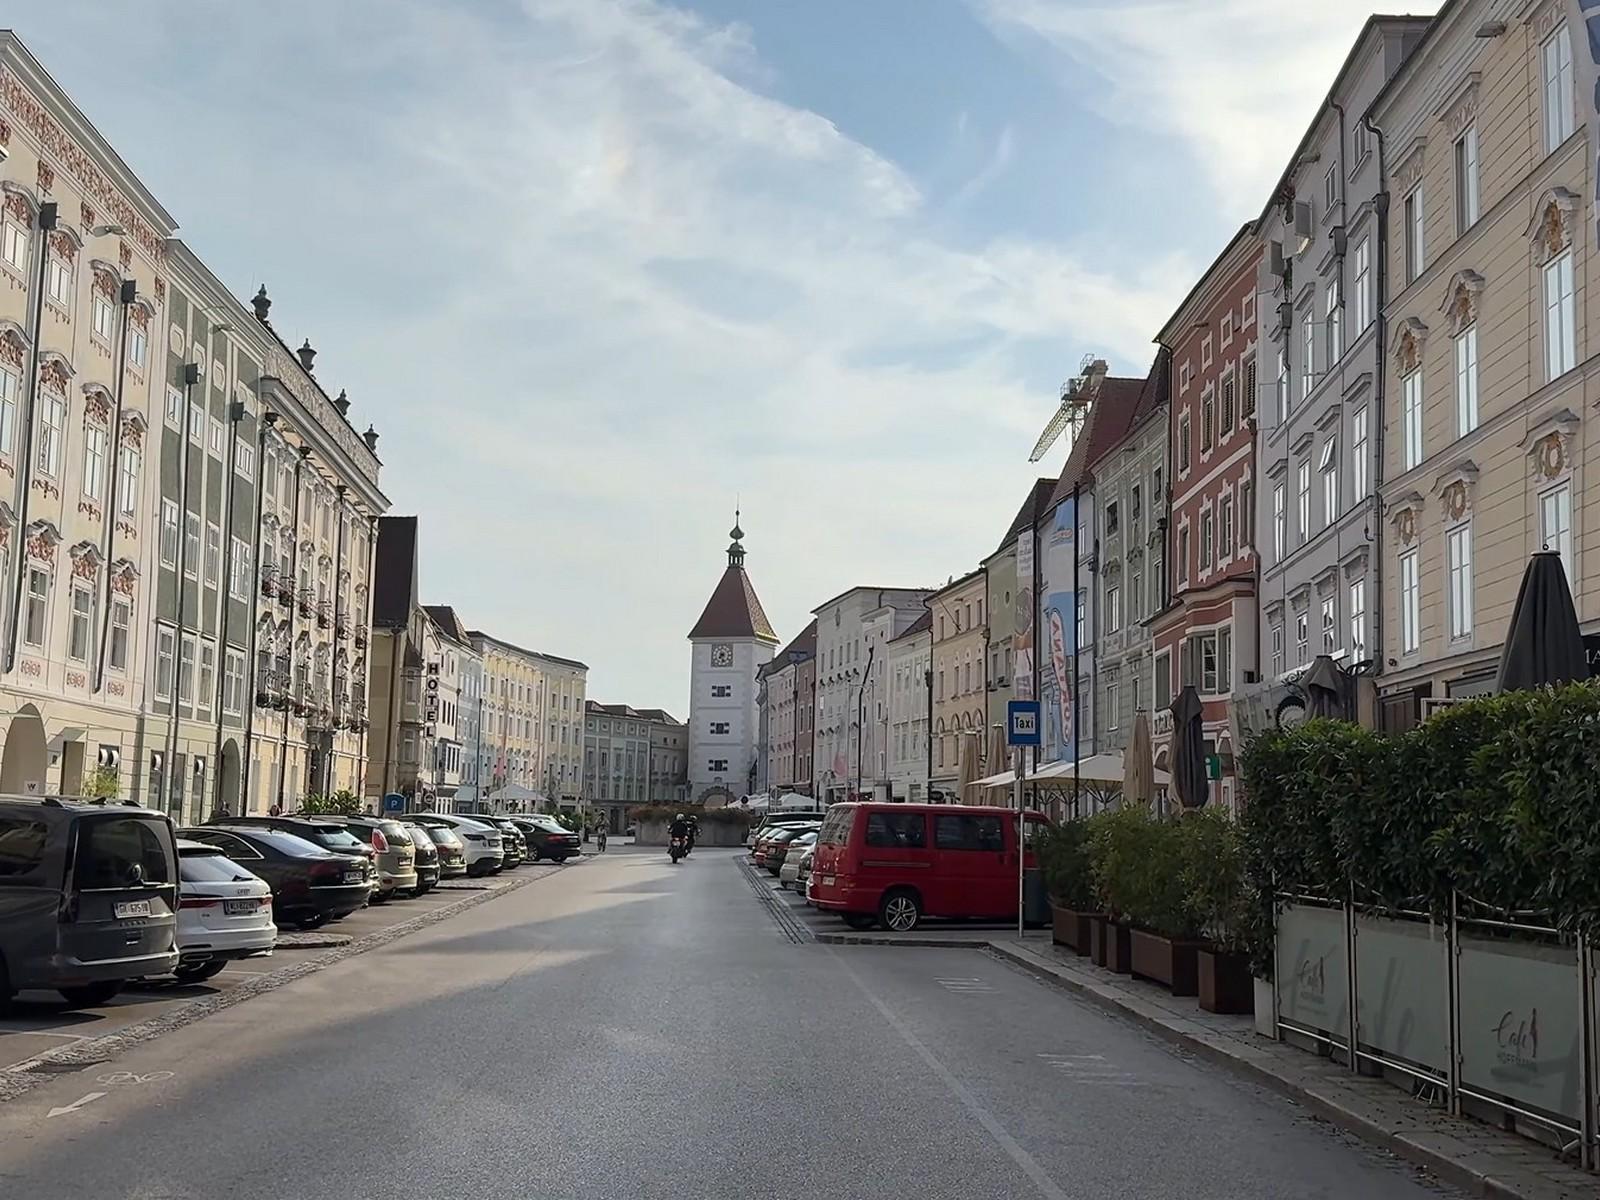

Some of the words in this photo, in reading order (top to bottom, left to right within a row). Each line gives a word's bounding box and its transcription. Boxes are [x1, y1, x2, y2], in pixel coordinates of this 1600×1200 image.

[426, 663, 439, 737] HOTEL
[1015, 716, 1034, 729] Taxi
[391, 800, 398, 809] P
